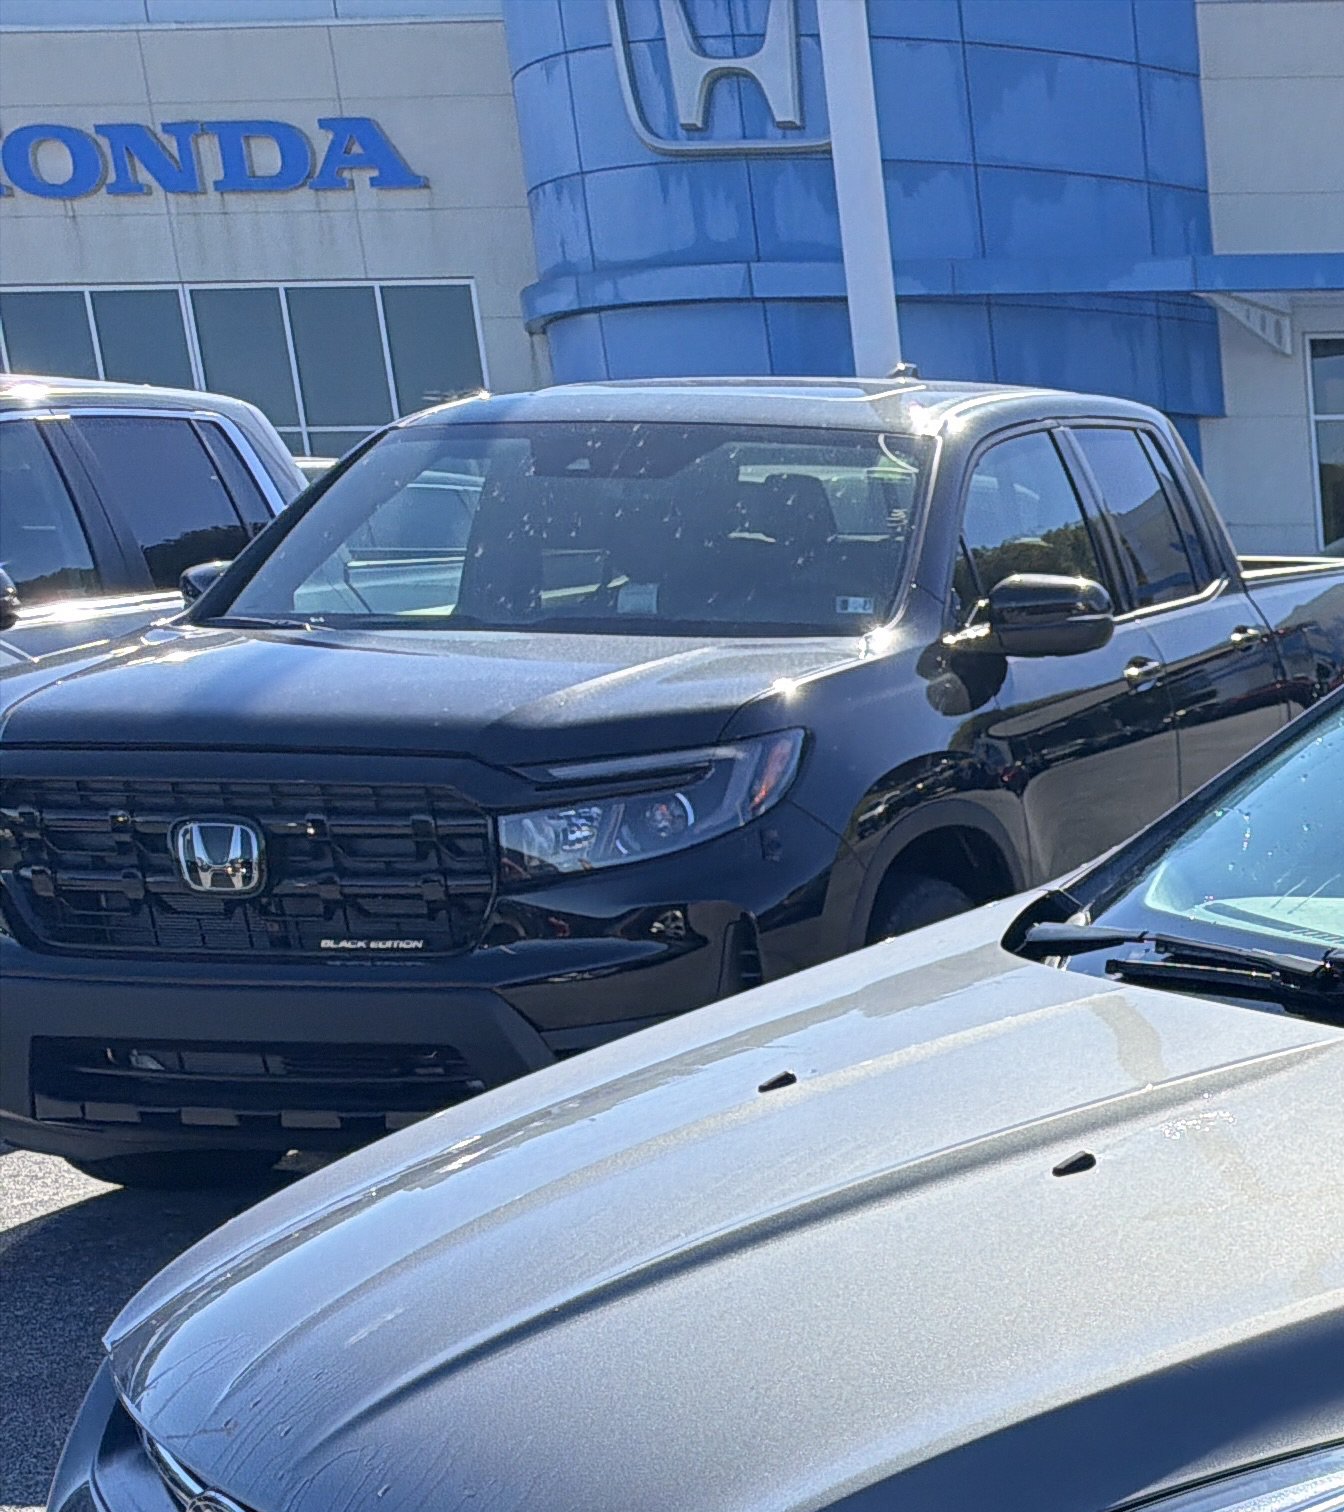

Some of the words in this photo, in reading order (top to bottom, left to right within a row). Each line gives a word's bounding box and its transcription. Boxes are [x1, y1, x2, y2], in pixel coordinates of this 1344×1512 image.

[0, 116, 430, 199] ONDA
[320, 939, 367, 949] BLACK
[369, 939, 424, 949] EDITION
